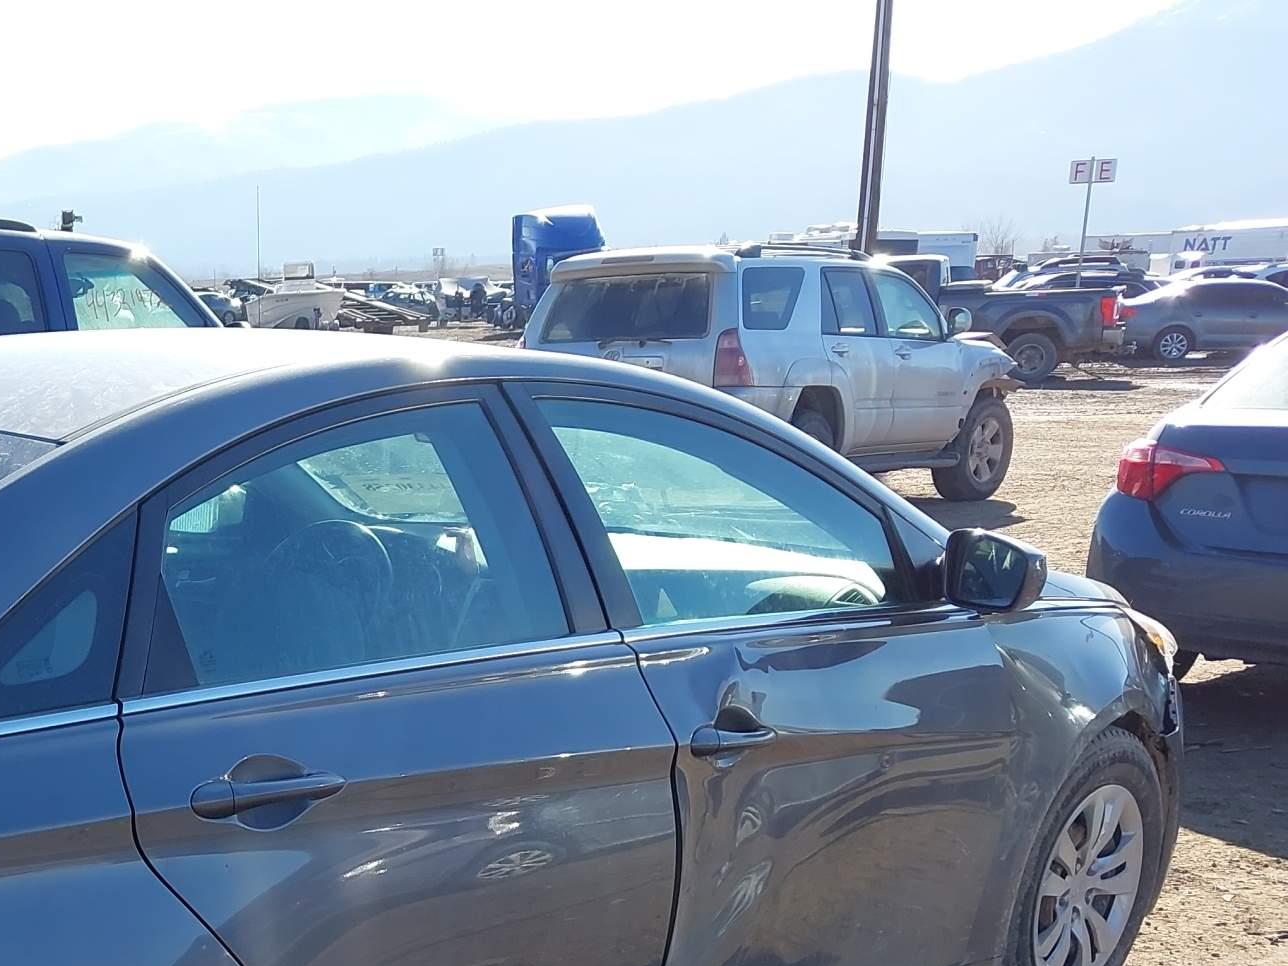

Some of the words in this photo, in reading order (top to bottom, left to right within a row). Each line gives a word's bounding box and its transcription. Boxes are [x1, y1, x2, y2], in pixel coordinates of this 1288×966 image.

[1074, 162, 1087, 181] F
[1099, 161, 1113, 180] E
[1183, 236, 1232, 255] NATT
[1179, 508, 1232, 521] COROLLA
